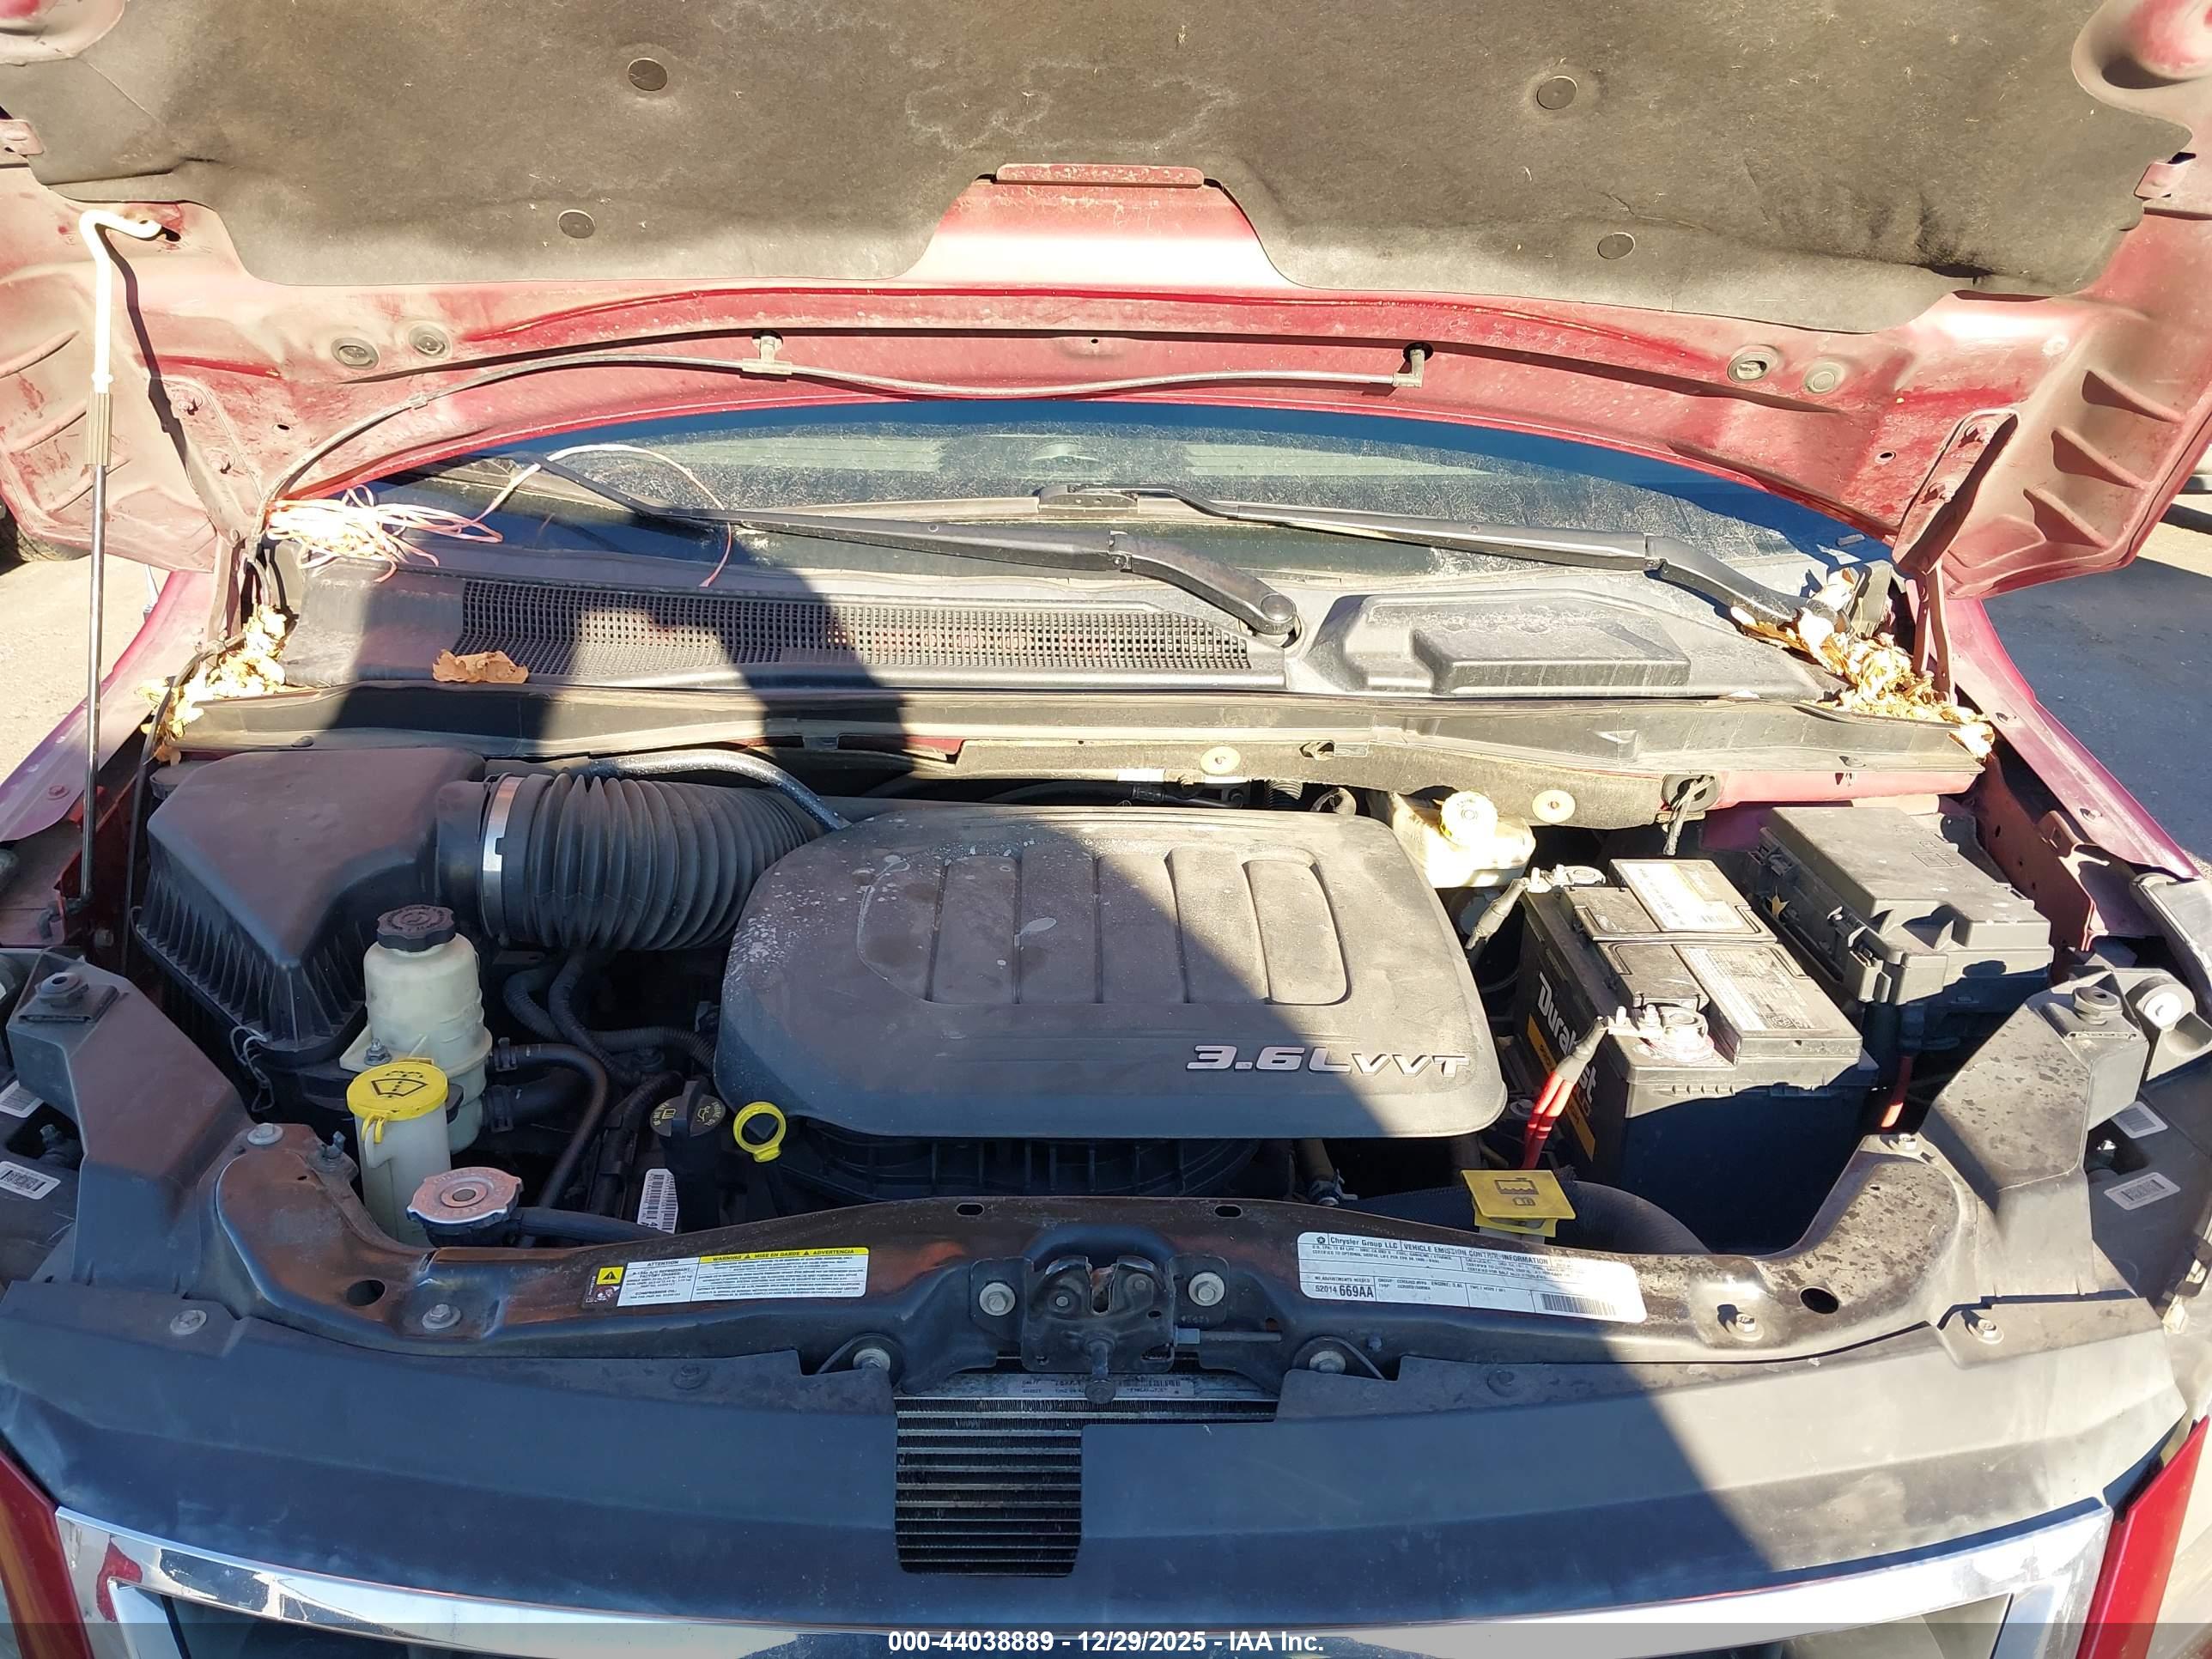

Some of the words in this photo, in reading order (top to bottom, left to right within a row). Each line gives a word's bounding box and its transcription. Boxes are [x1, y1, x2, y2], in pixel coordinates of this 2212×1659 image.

[1330, 1237, 1359, 1246] Chrysler
[1362, 1239, 1382, 1249] Group
[1404, 1243, 1432, 1252] VEHICLE
[1434, 1247, 1468, 1256] EMISSION
[1502, 1254, 1548, 1265] INFORMATION
[1340, 1285, 1375, 1297] 669AA
